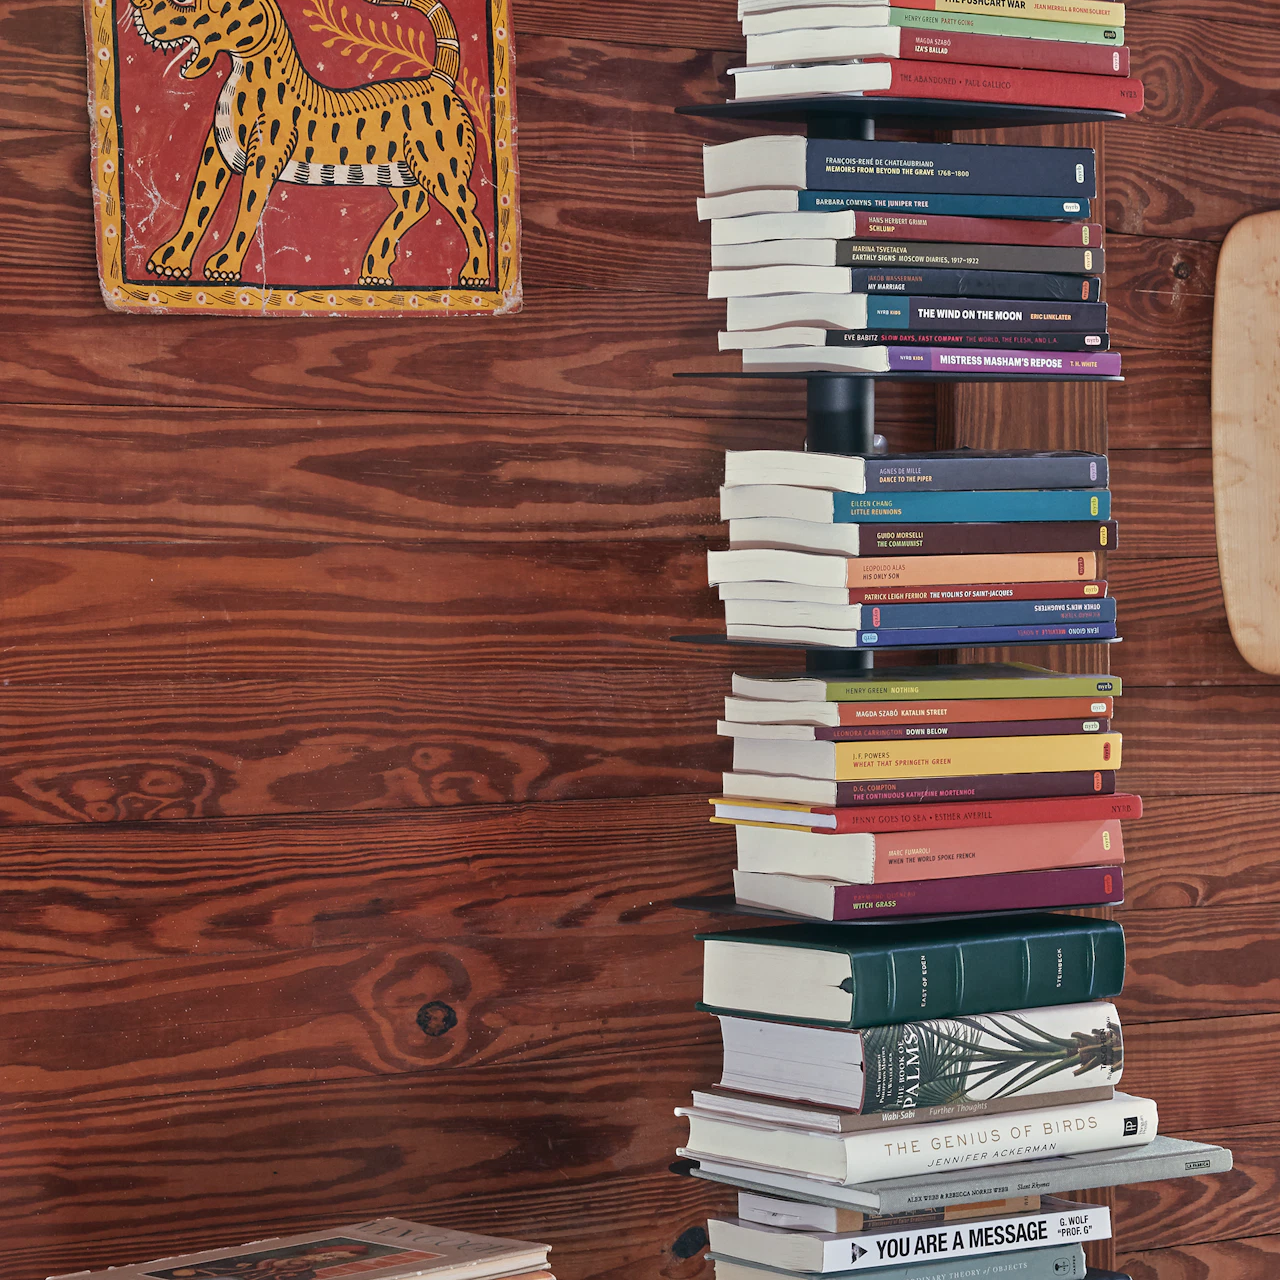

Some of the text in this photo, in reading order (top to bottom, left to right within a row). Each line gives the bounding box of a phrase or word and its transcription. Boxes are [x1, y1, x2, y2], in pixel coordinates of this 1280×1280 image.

[1007, 0, 1026, 9] WAR
[918, 308, 1022, 321] THE WIND ON THE MOON
[940, 355, 1062, 368] MISTRESS MASHAM'S REPOSE
[879, 708, 898, 717] SZABÓ
[906, 728, 925, 736] DOWN
[898, 1042, 904, 1053] OF
[902, 1029, 920, 1109] PALMS
[897, 1082, 905, 1105] THE
[884, 1116, 1098, 1156] THE GENIUS OF BIRDS
[928, 1143, 1057, 1167] JENNIFER ACKERMAN
[1059, 1215, 1089, 1226] G. WOLF
[876, 1220, 1048, 1260] YOU ARE A MESSAGE
